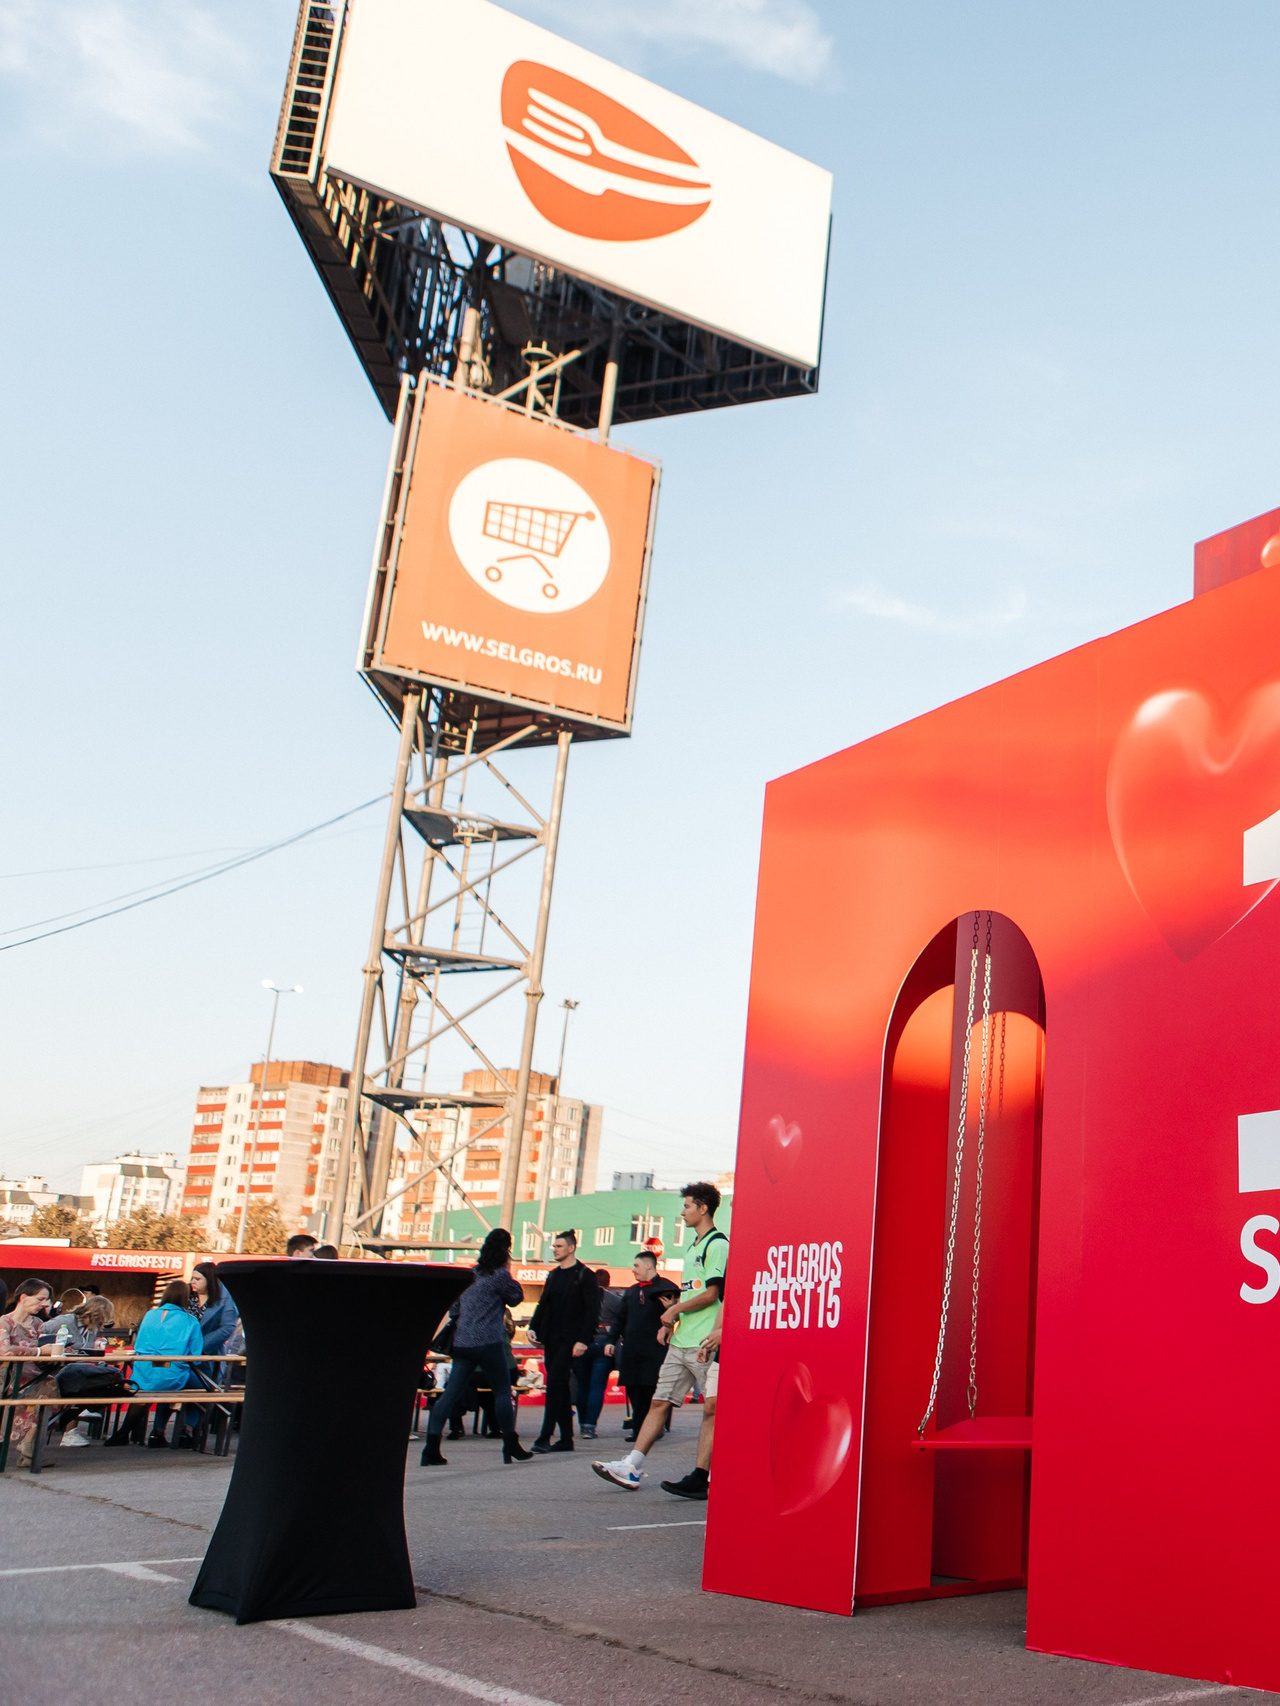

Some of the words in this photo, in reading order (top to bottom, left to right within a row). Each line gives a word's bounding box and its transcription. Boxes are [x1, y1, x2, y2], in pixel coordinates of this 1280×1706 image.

[421, 620, 602, 684] WWW.SELGROS.RU
[91, 1253, 183, 1269] #SELGROSFEST15
[766, 1241, 843, 1285] SELGROS
